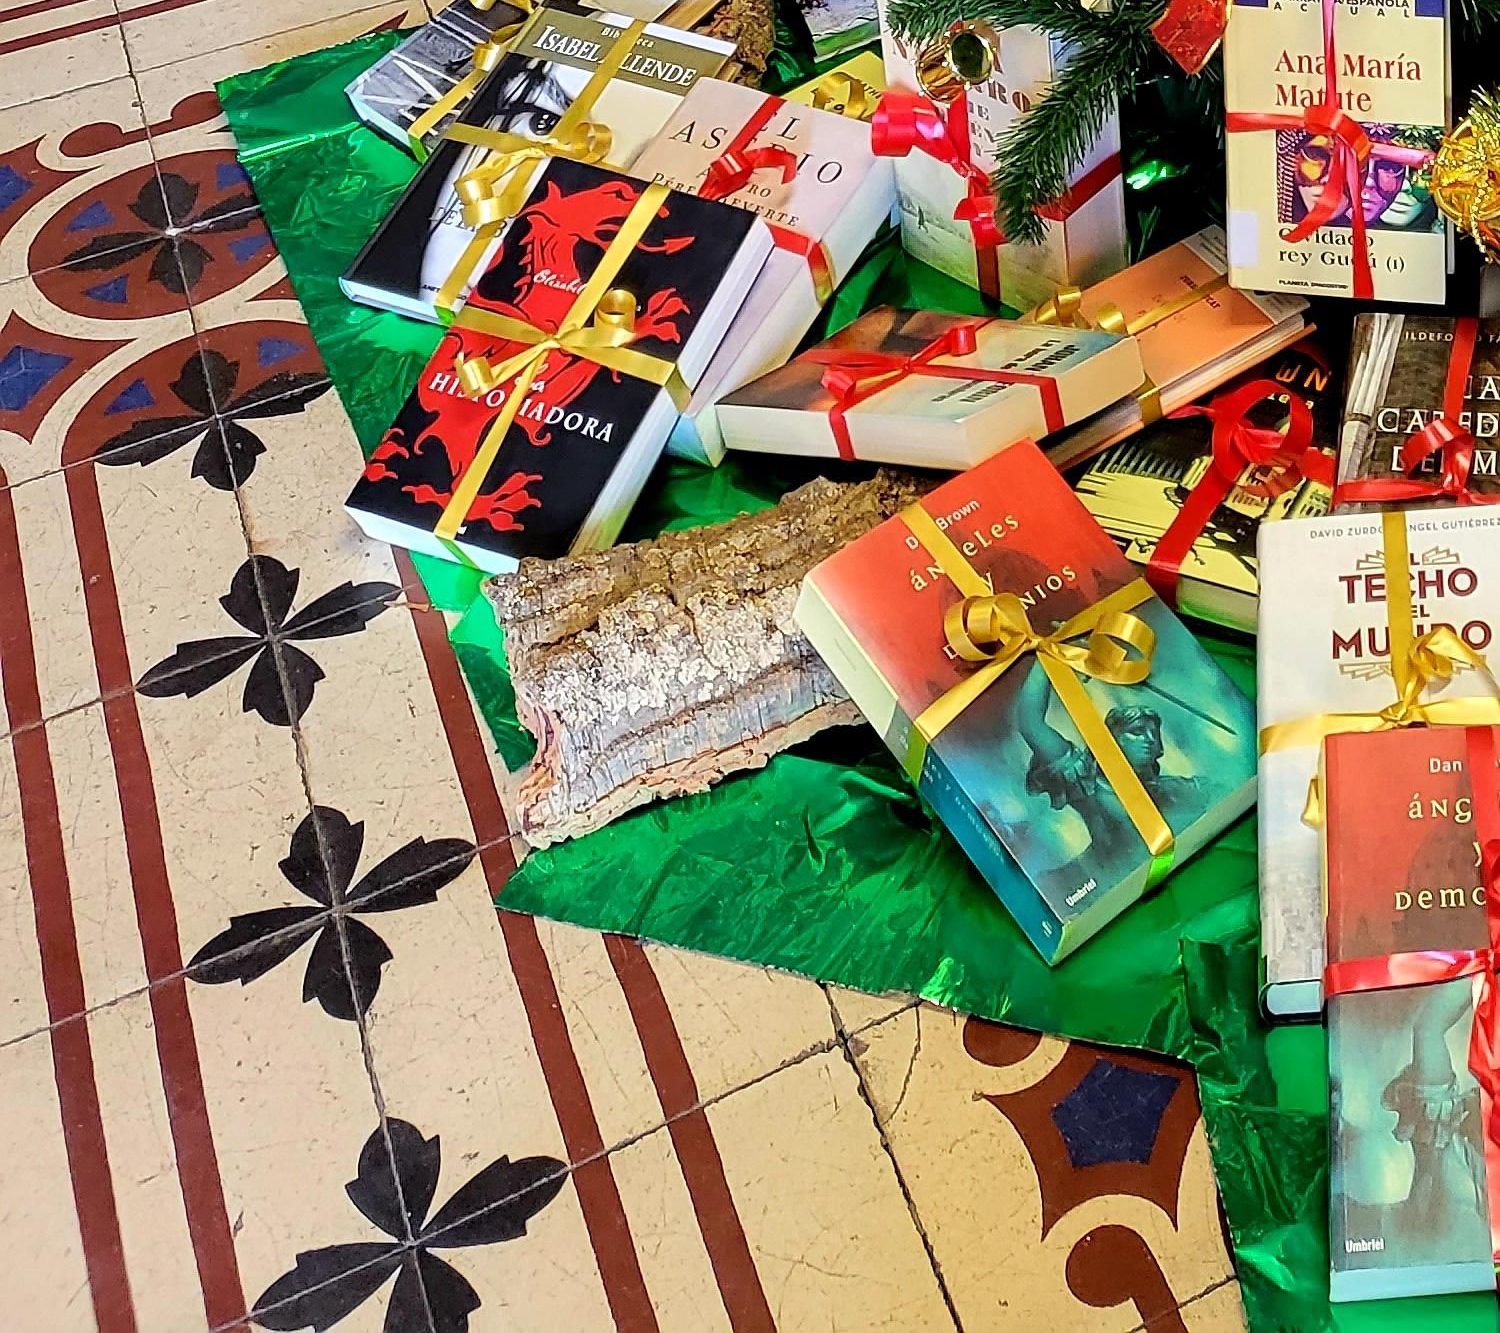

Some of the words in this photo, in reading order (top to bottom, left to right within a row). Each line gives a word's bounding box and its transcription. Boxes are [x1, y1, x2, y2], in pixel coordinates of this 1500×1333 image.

[532, 26, 602, 64] ISABEL
[618, 50, 697, 87] LLENDE
[1274, 49, 1326, 73] Ana
[1342, 54, 1422, 81] María
[1278, 248, 1314, 269] rey
[1278, 279, 1310, 288] PLANETA
[936, 498, 981, 533] Brown
[1310, 527, 1343, 539] DAVID
[1428, 757, 1462, 775] Dan
[1065, 878, 1098, 908] Umbriel
[1344, 1239, 1385, 1254] Umbriel
